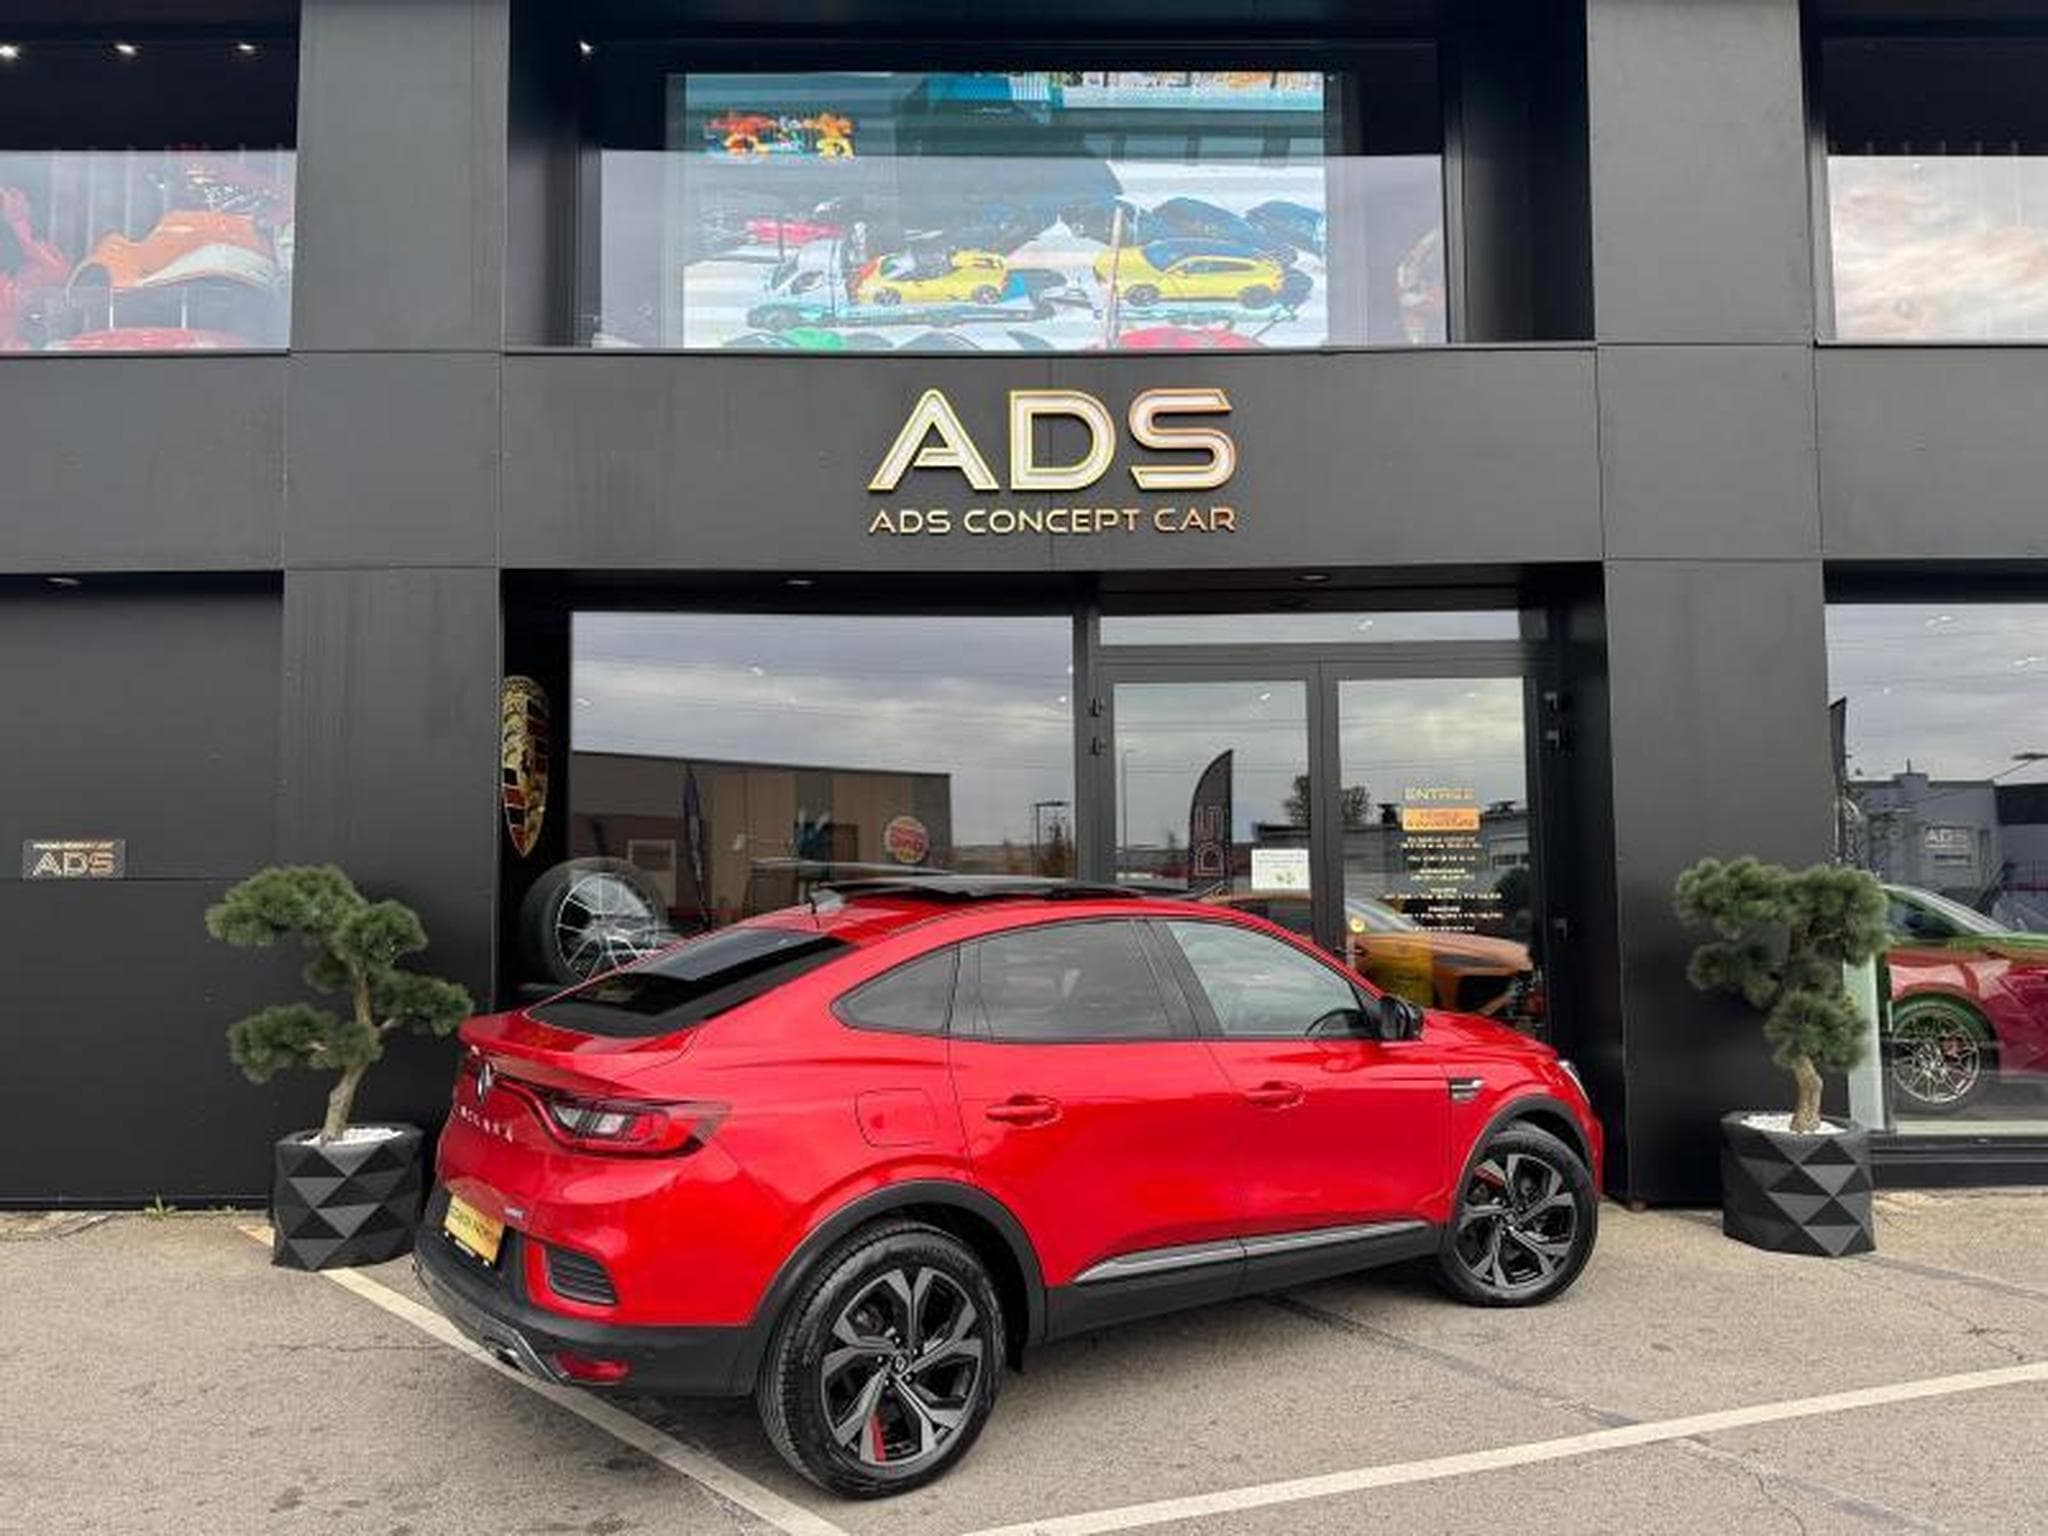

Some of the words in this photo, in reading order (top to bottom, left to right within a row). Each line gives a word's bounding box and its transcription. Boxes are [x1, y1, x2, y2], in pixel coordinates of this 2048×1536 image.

[867, 387, 1237, 491] ADS
[868, 508, 951, 535] ADS
[963, 508, 1141, 534] CONCEPT
[1153, 507, 1237, 532] CAR
[32, 851, 115, 877] ADS
